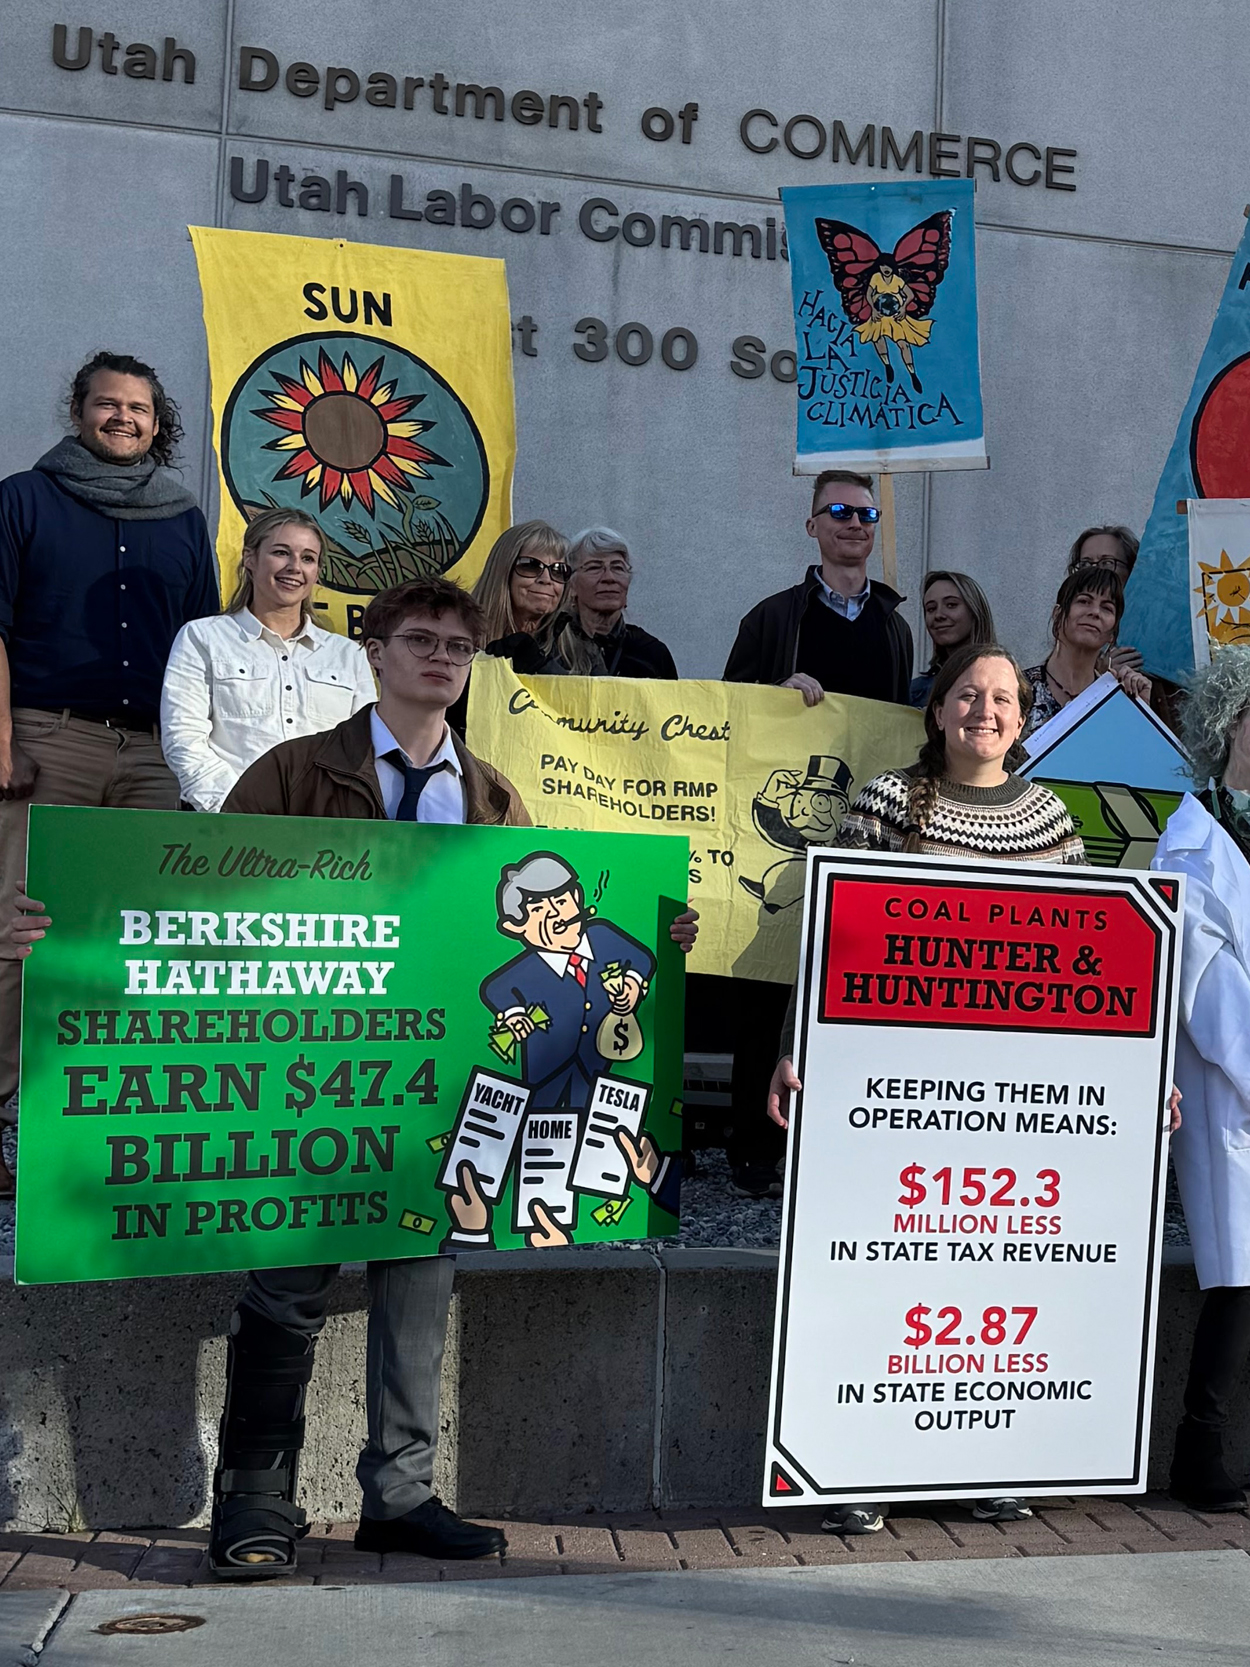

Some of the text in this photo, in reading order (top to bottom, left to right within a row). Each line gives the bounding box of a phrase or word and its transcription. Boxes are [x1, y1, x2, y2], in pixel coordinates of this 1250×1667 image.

[52, 23, 1077, 192] Utah Department of COMMERCE
[230, 157, 789, 261] Utah Labor Commi
[302, 282, 392, 327] SUN
[798, 289, 857, 357] HACIA
[574, 317, 697, 371] 300
[730, 335, 797, 383] So
[803, 332, 850, 373] LA
[797, 365, 911, 405] JUSTICIA
[661, 714, 731, 742] Chest
[540, 754, 718, 798] PAY DAY FOR RMP
[542, 777, 716, 822] SHAREHOLDERS!
[159, 843, 372, 881] The Ultra-Rich
[707, 849, 734, 867] TO
[119, 909, 400, 948] BERKSHIRE
[884, 897, 1109, 931] COAL PLANTS
[883, 933, 1103, 977] HUNTER &
[124, 959, 394, 995] HATHAWAY
[841, 971, 1137, 1017] HUNTINGTON
[57, 1007, 446, 1046] SHAREHOLDERS
[614, 1018, 629, 1056] $
[62, 1053, 439, 1118] EARN $47.4
[473, 1082, 640, 1116] YACHT TESLA
[866, 1077, 1105, 1107] KEEPING THEM IN
[528, 1119, 572, 1140] HOME
[848, 1106, 1118, 1136] OPERATION MEANS:
[105, 1125, 400, 1185] BILLION
[897, 1162, 1061, 1210] $152.3
[111, 1190, 388, 1240] IN PROFITS
[893, 1213, 1062, 1235] MILLION LESS
[830, 1241, 1117, 1263] IN STATE TAX REVENUE
[903, 1302, 1039, 1350] $2.87
[887, 1352, 1049, 1375] BILLION LESS
[837, 1379, 1093, 1404] IN STATE ECONOMIC
[914, 1408, 1016, 1432] OUTPUT
